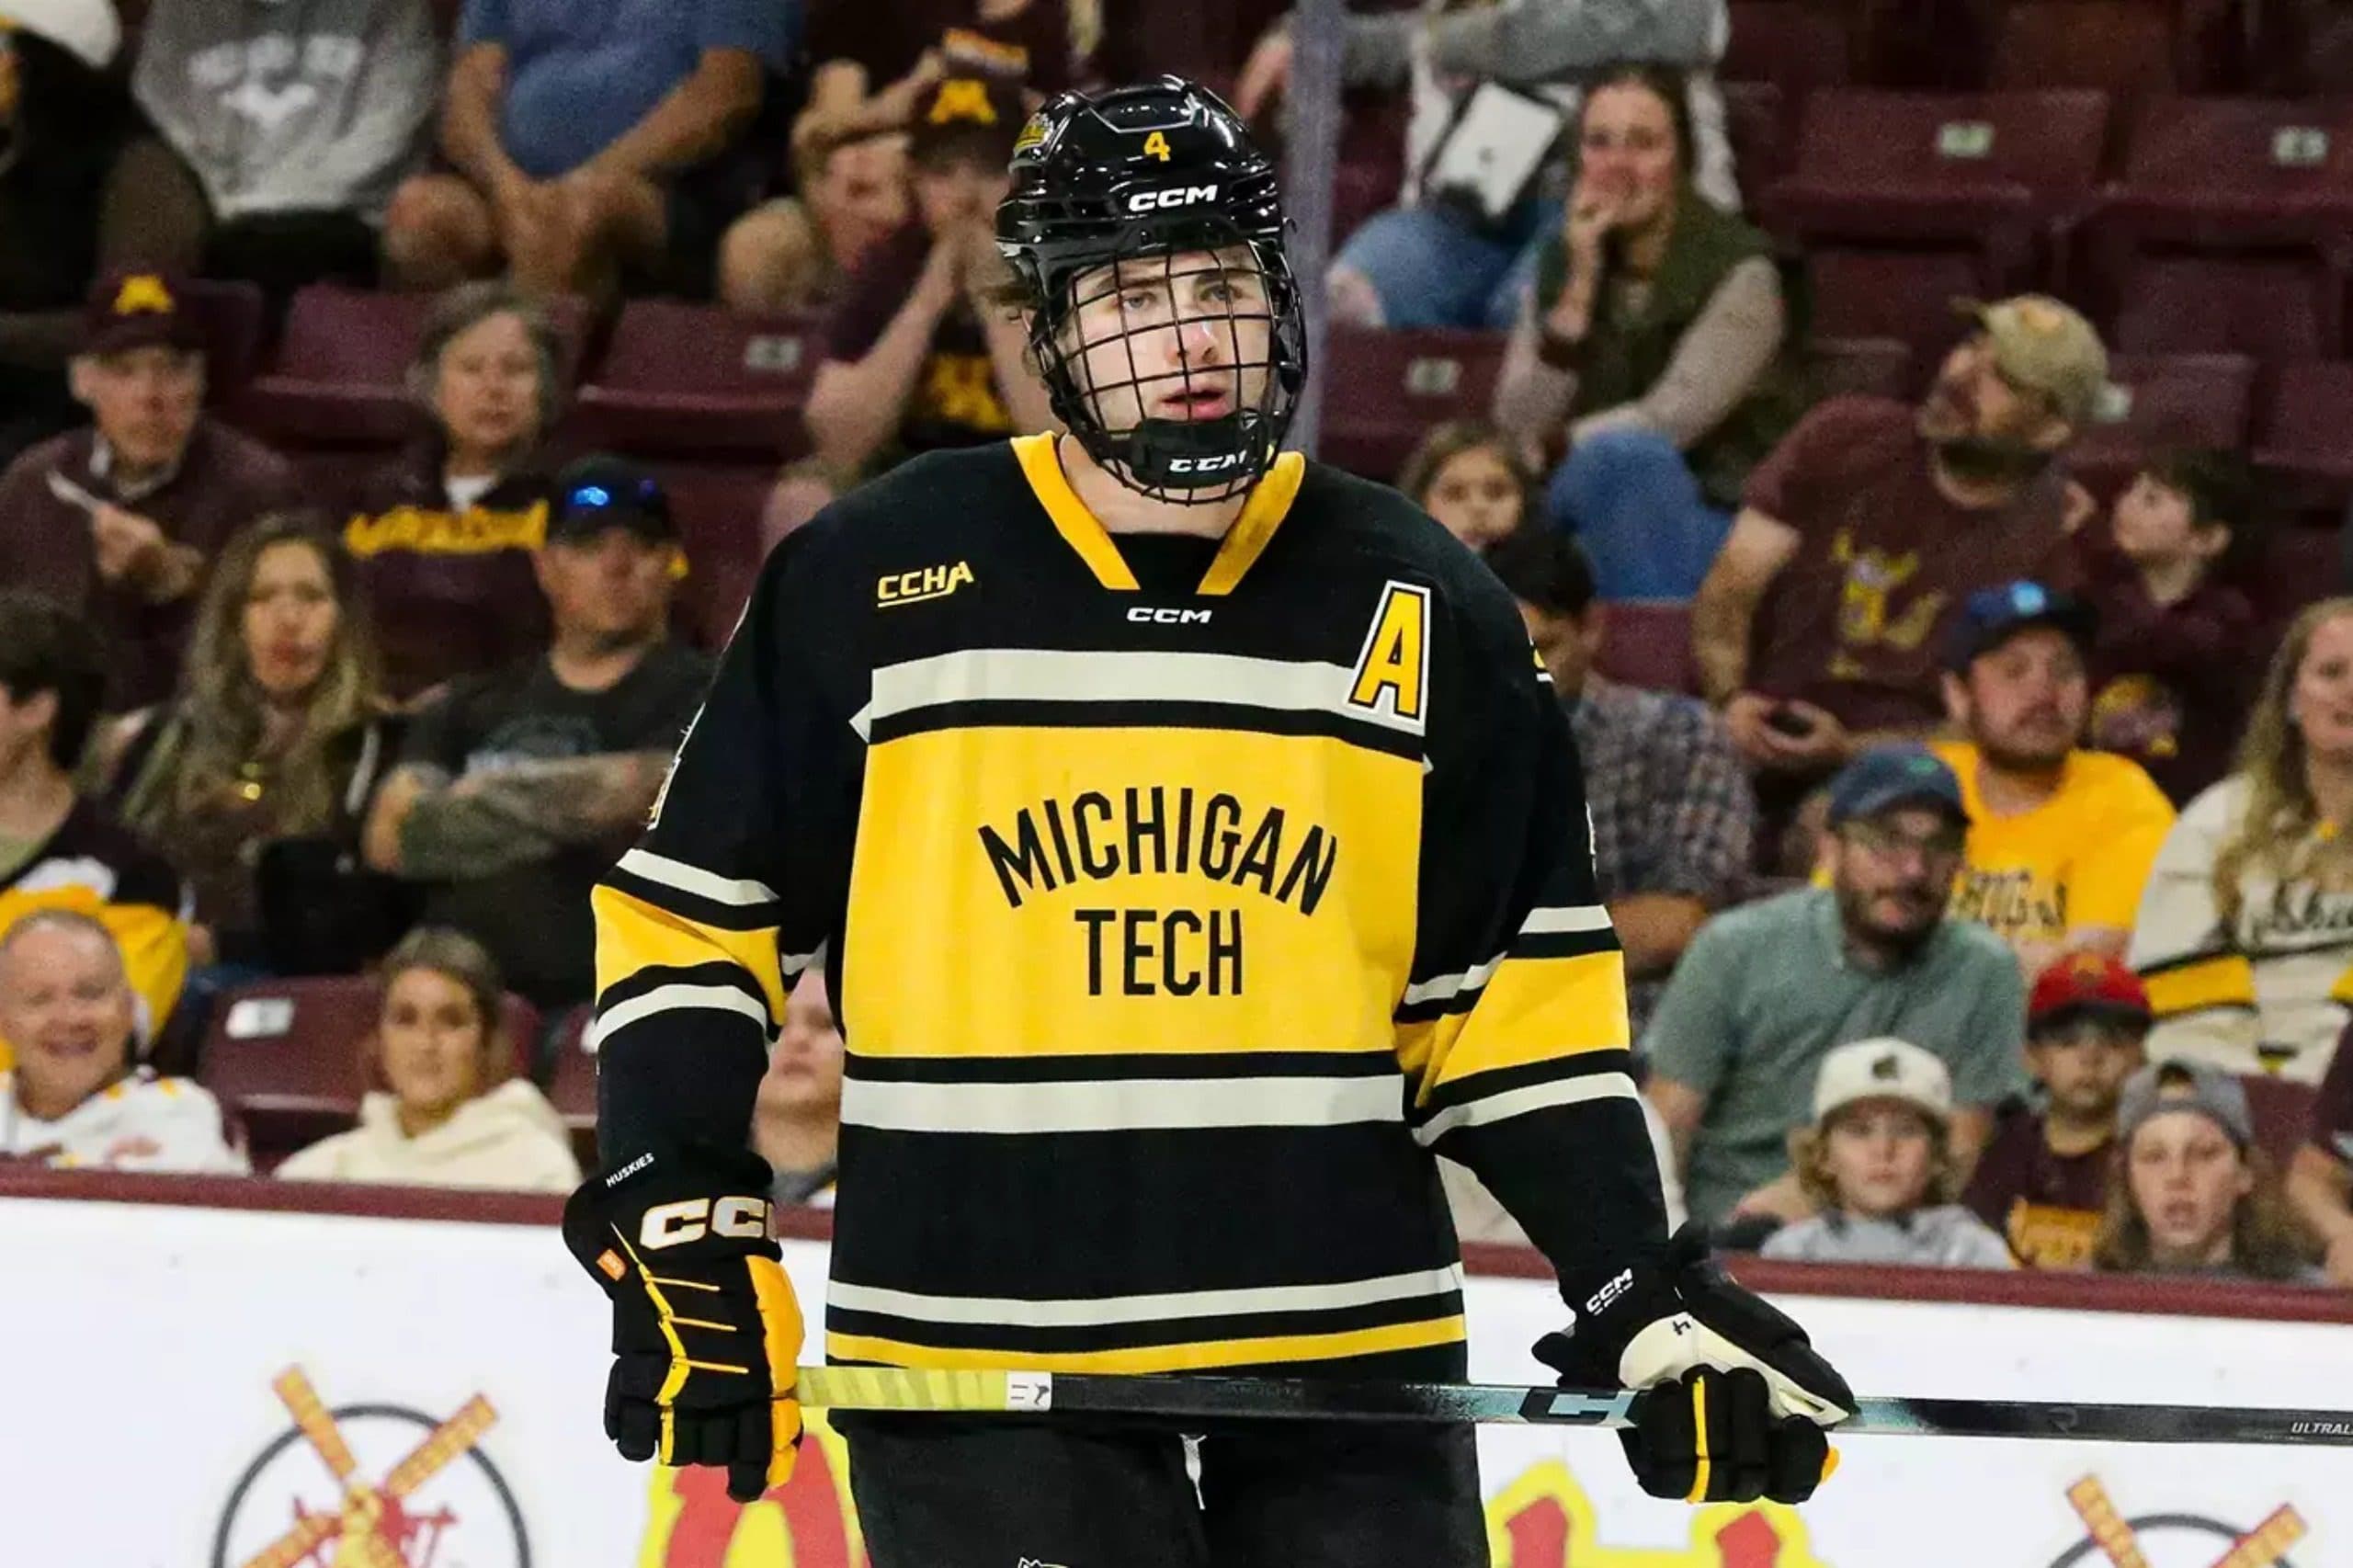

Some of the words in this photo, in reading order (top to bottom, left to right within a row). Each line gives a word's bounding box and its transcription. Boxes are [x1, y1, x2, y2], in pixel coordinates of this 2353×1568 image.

[1143, 131, 1171, 162] 4
[1128, 185, 1218, 212] CCM
[877, 561, 974, 607] CCHA
[1127, 608, 1212, 623] CCM
[1347, 579, 1430, 724] A
[978, 786, 1337, 917] MICHIGAN
[1074, 908, 1243, 996] TECH
[606, 1152, 655, 1188] HUSKIES
[640, 1195, 777, 1250] CC
[1586, 1267, 1633, 1312] CCM
